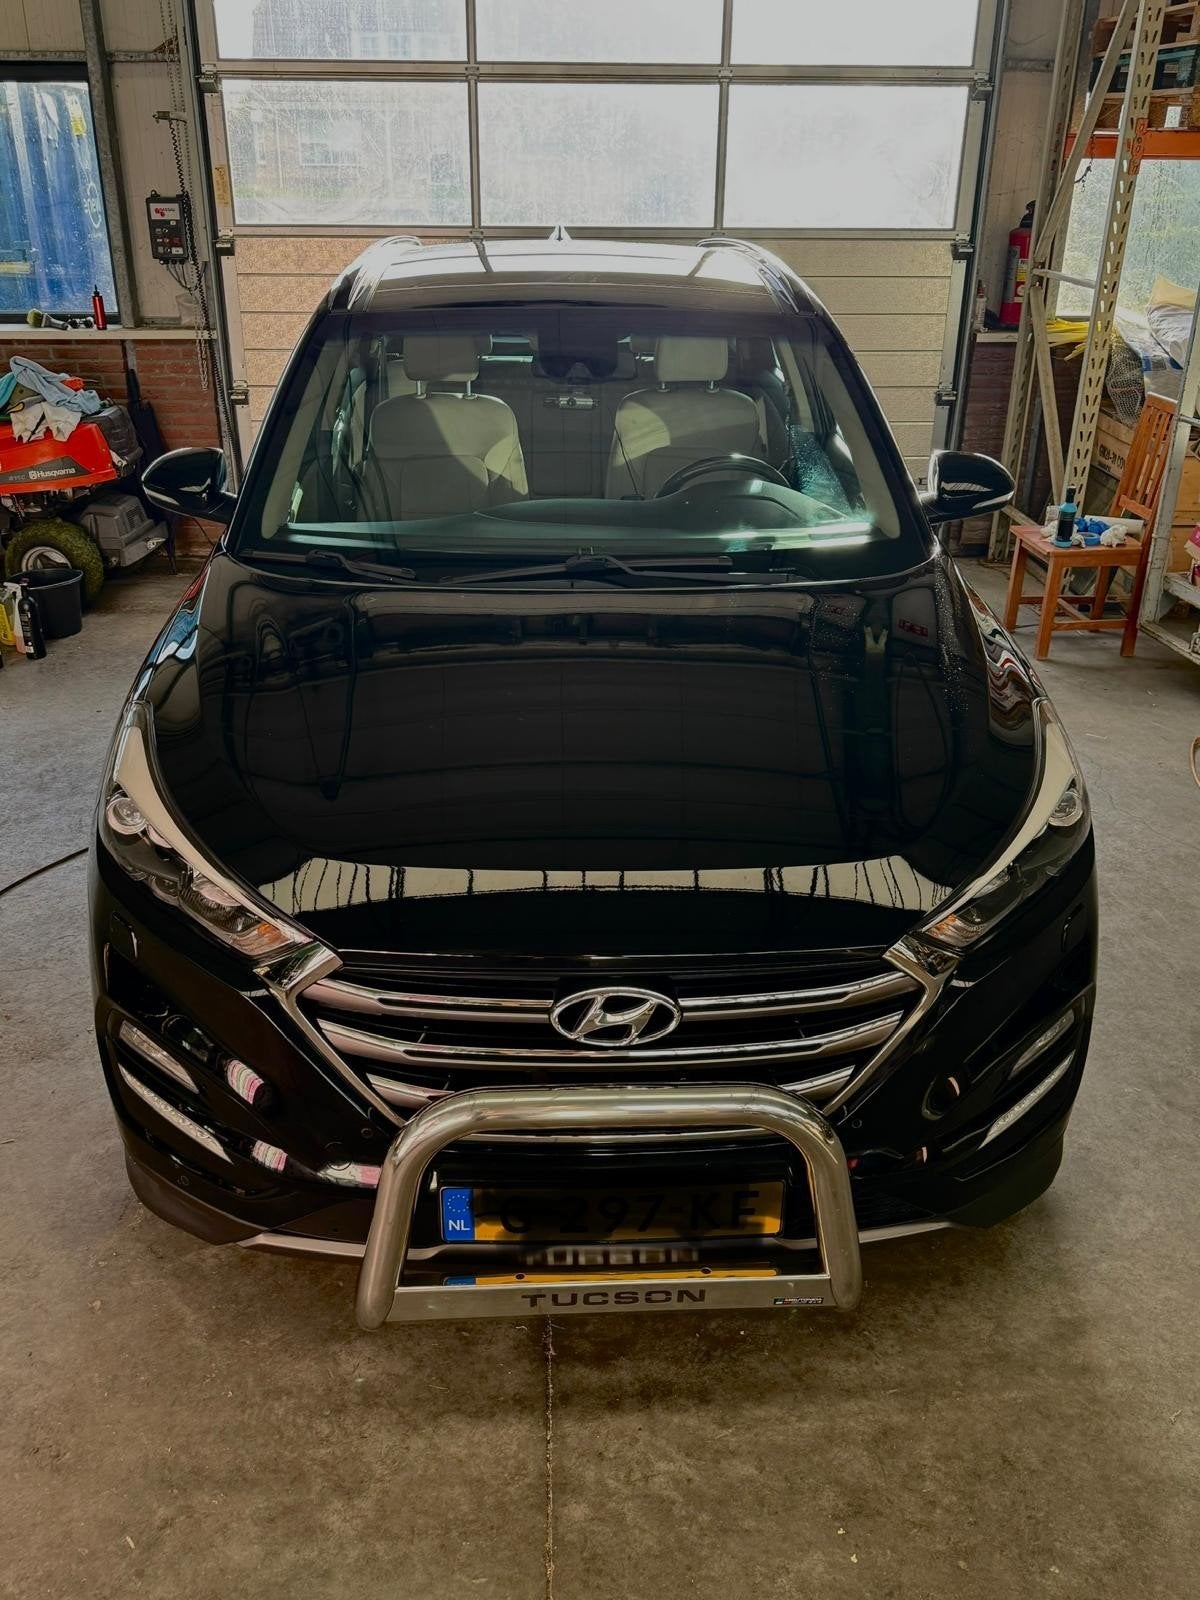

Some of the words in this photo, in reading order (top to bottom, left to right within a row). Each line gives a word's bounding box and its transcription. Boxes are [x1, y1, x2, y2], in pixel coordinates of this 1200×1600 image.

[37, 467, 76, 477] Husqvarna
[448, 1219, 471, 1231] NL
[521, 1288, 706, 1308] TUCSON
